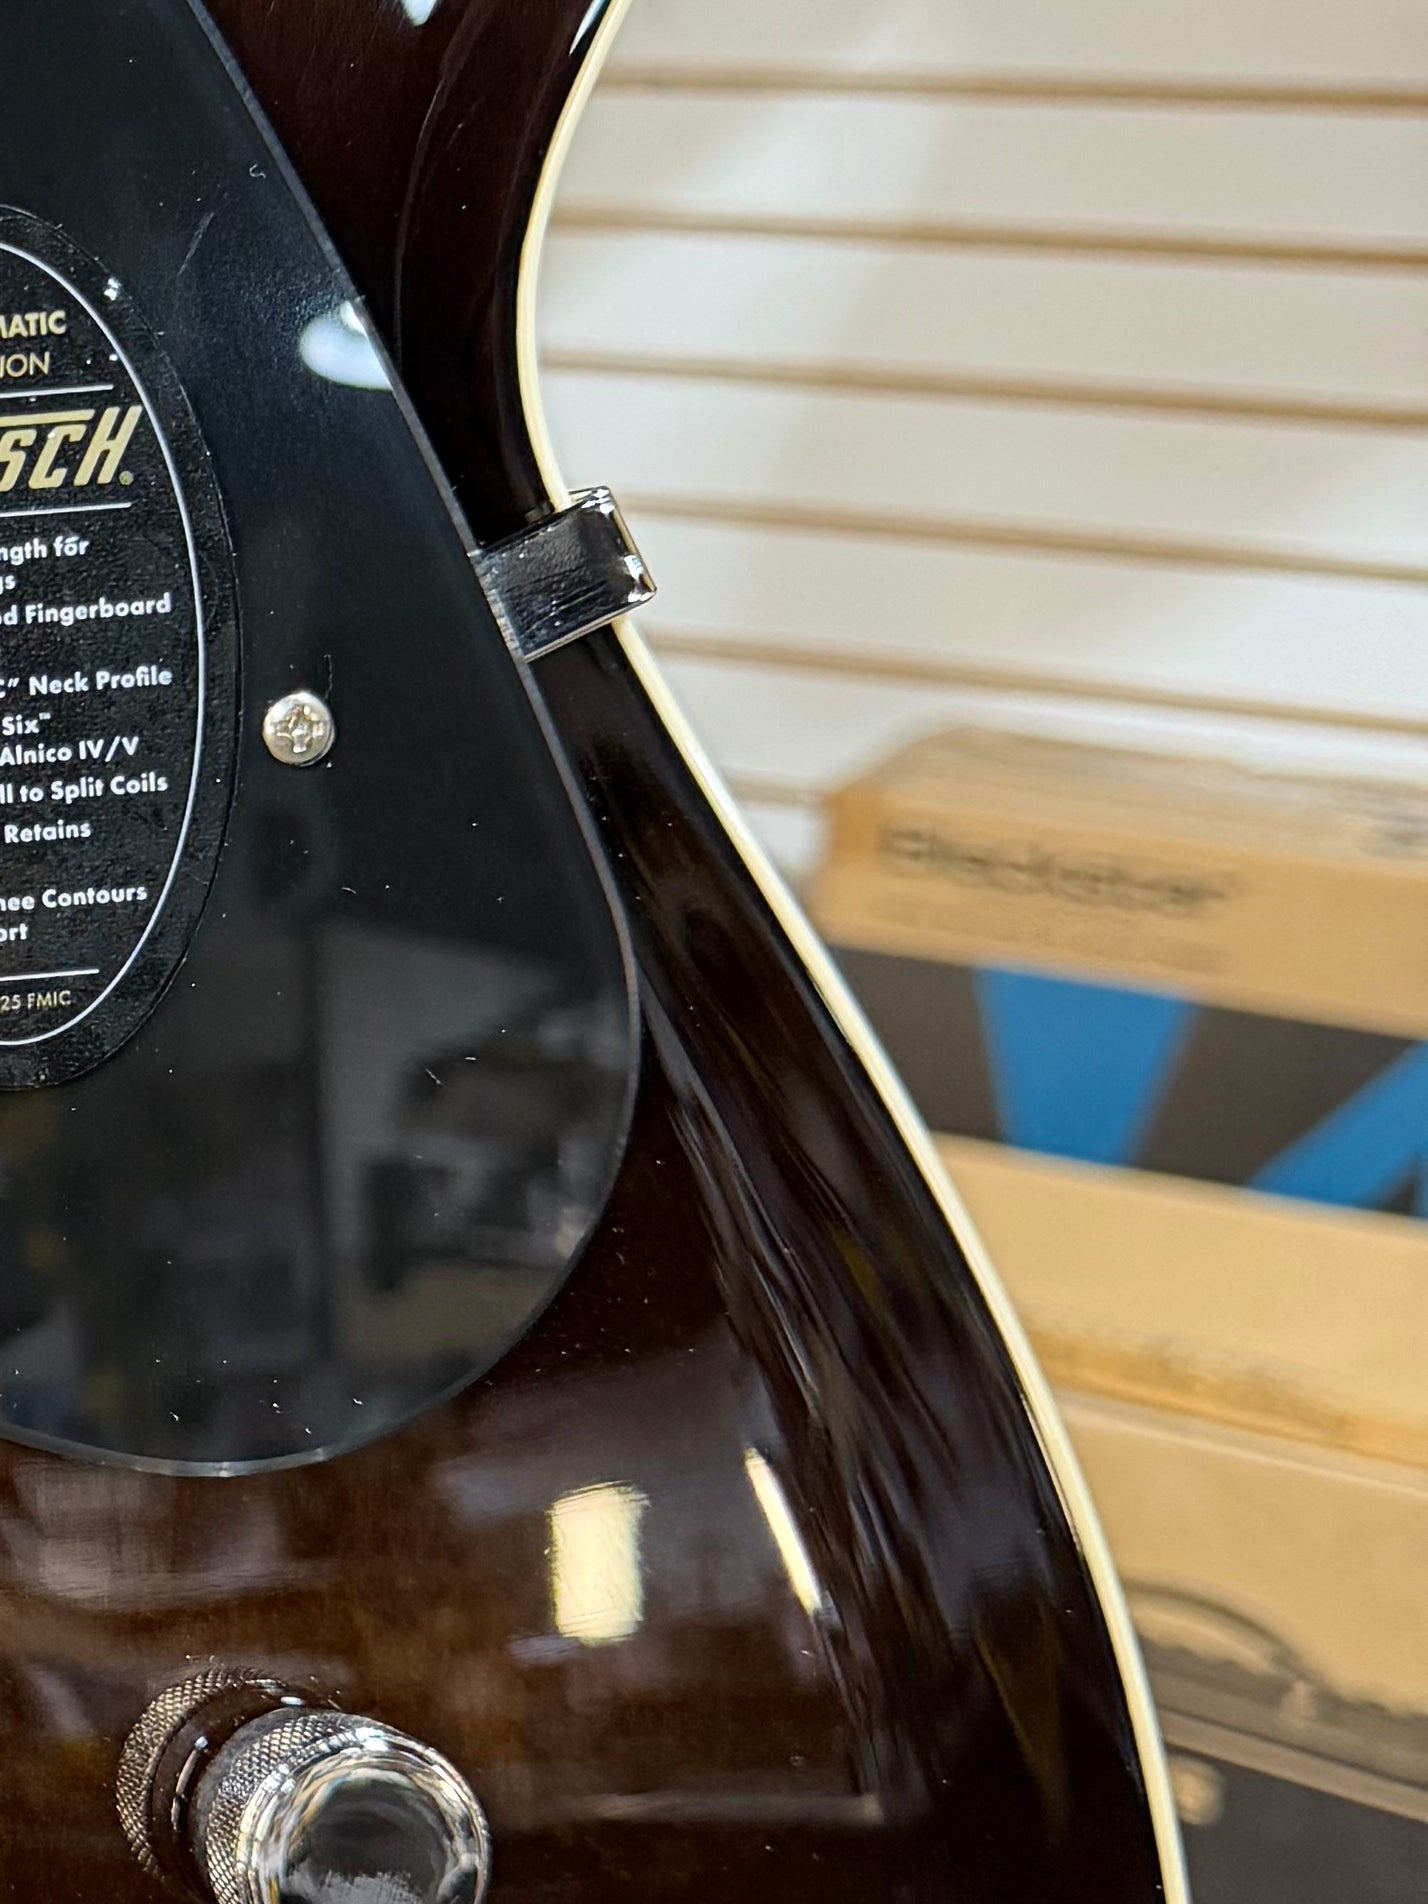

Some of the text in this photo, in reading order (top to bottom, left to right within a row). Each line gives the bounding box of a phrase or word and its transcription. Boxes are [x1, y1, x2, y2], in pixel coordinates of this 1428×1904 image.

[52, 532, 90, 557] for
[24, 591, 172, 627] Fingerboard
[28, 670, 90, 696] Neck
[95, 663, 173, 691] Profile
[78, 735, 140, 763] IV/V
[19, 784, 45, 803] to
[50, 775, 105, 805] Split
[109, 770, 169, 796] Coils
[3, 818, 92, 844] Retains
[41, 886, 148, 909] Contours
[27, 989, 72, 1010] FMIC
